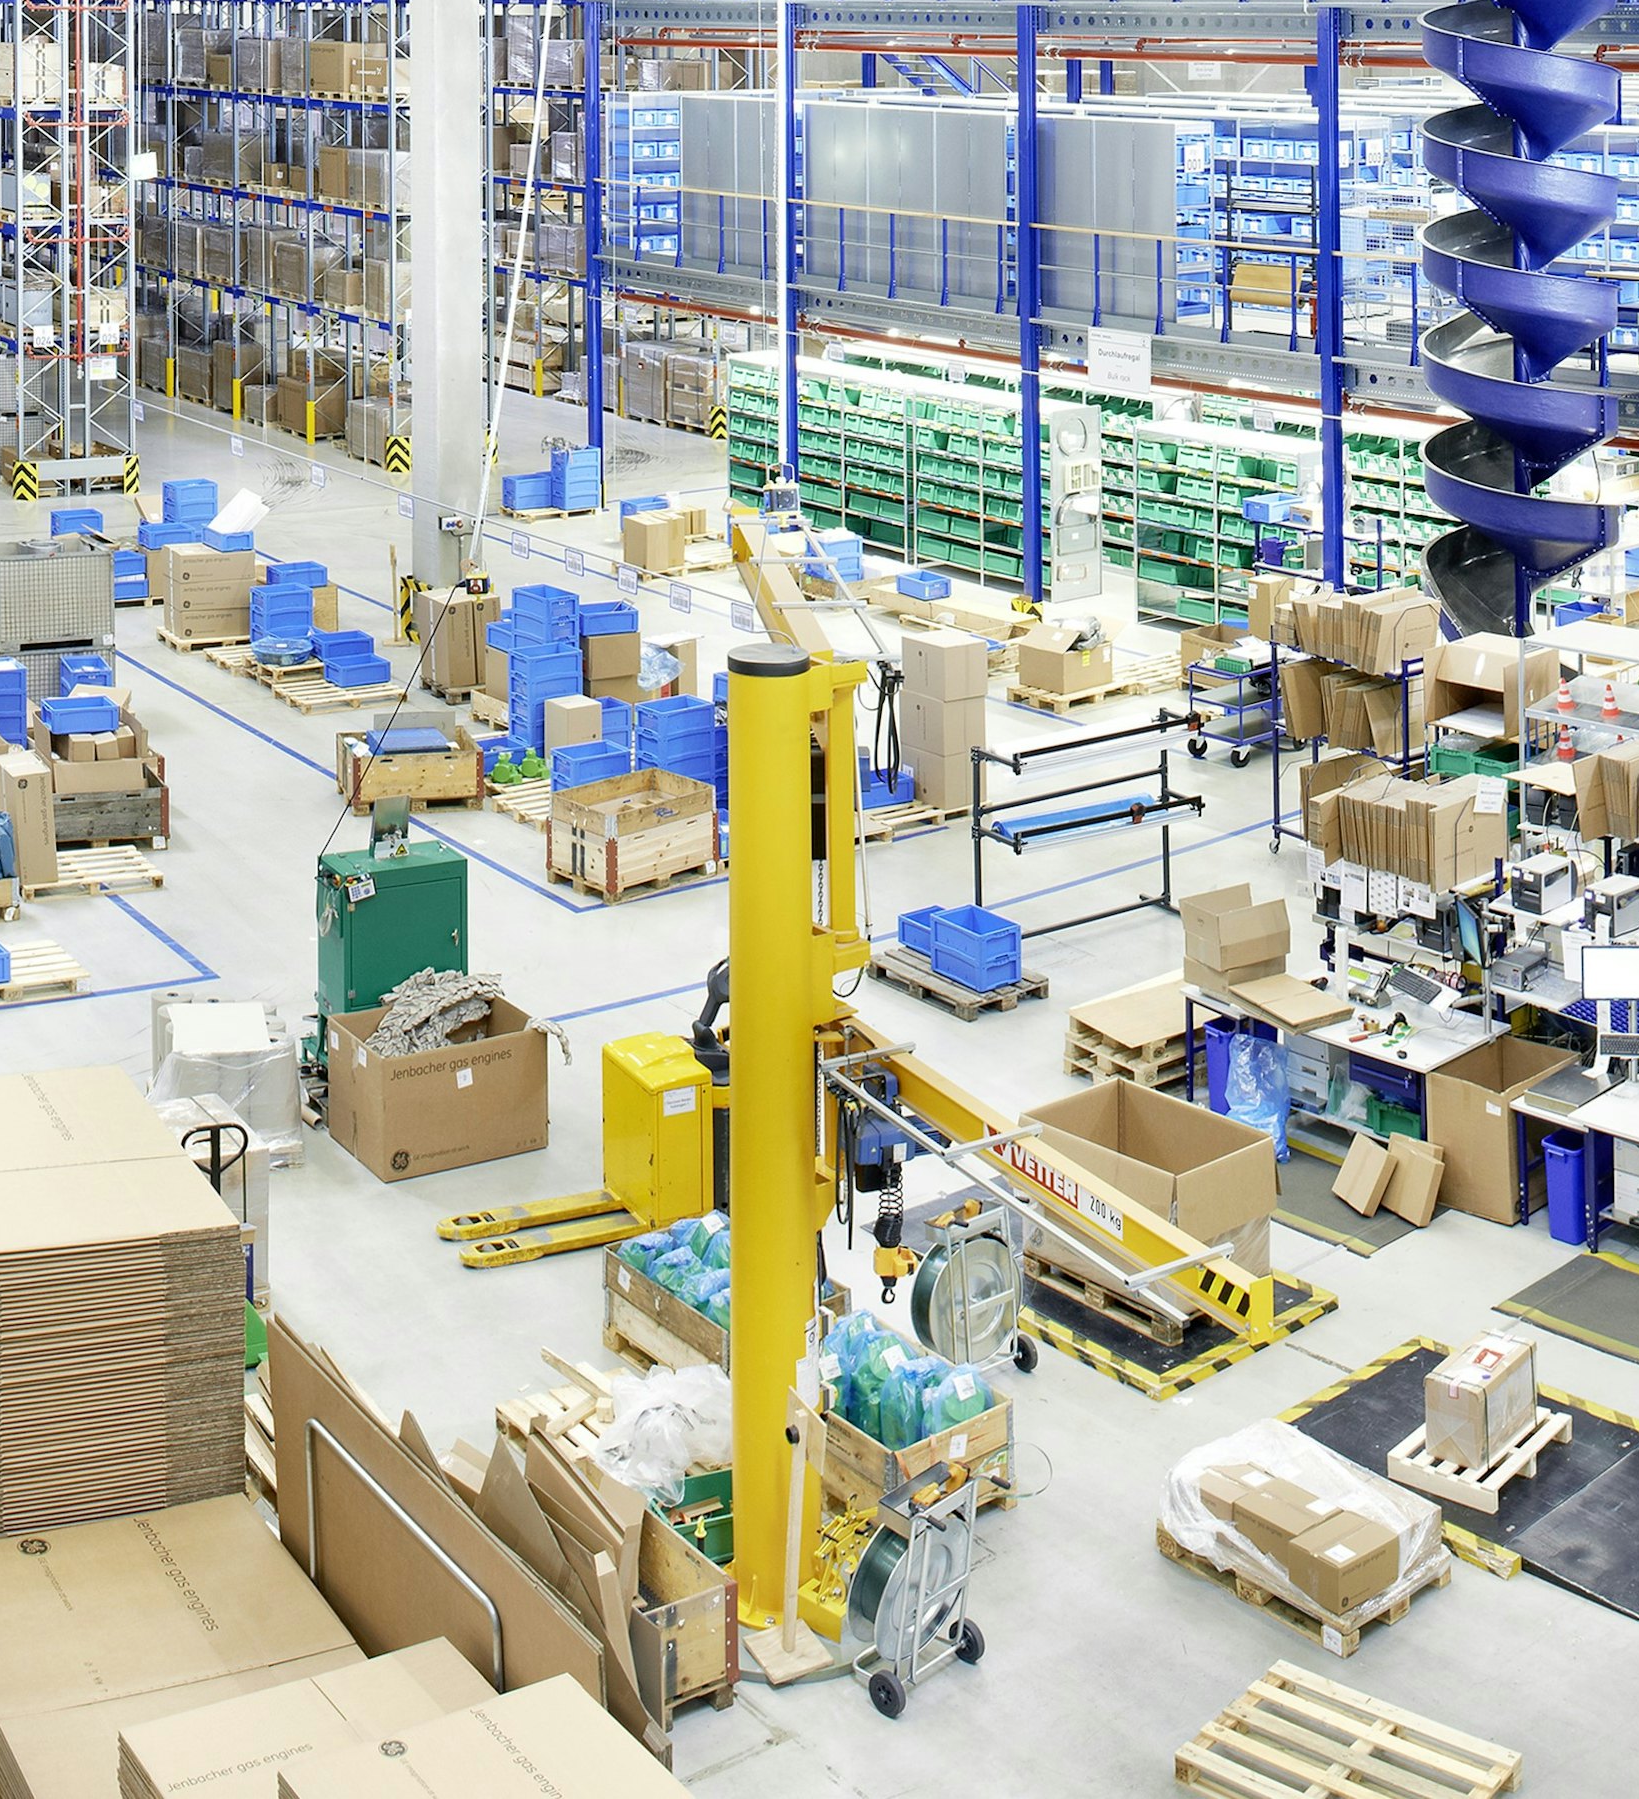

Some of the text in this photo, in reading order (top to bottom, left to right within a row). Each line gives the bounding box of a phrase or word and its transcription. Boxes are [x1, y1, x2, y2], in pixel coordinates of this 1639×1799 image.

[35, 336, 51, 345] 024
[102, 332, 117, 341] 025
[1098, 348, 1140, 362] Durchlaufregal
[391, 1050, 512, 1082] Jenbacher gas engines
[1010, 1143, 1122, 1231] VETTER 200 kg
[133, 1518, 219, 1632] Jenbacher gas engines
[166, 1742, 313, 1792] Jenbacher gas engines
[469, 1708, 563, 1798] Jenbacher gas engin
